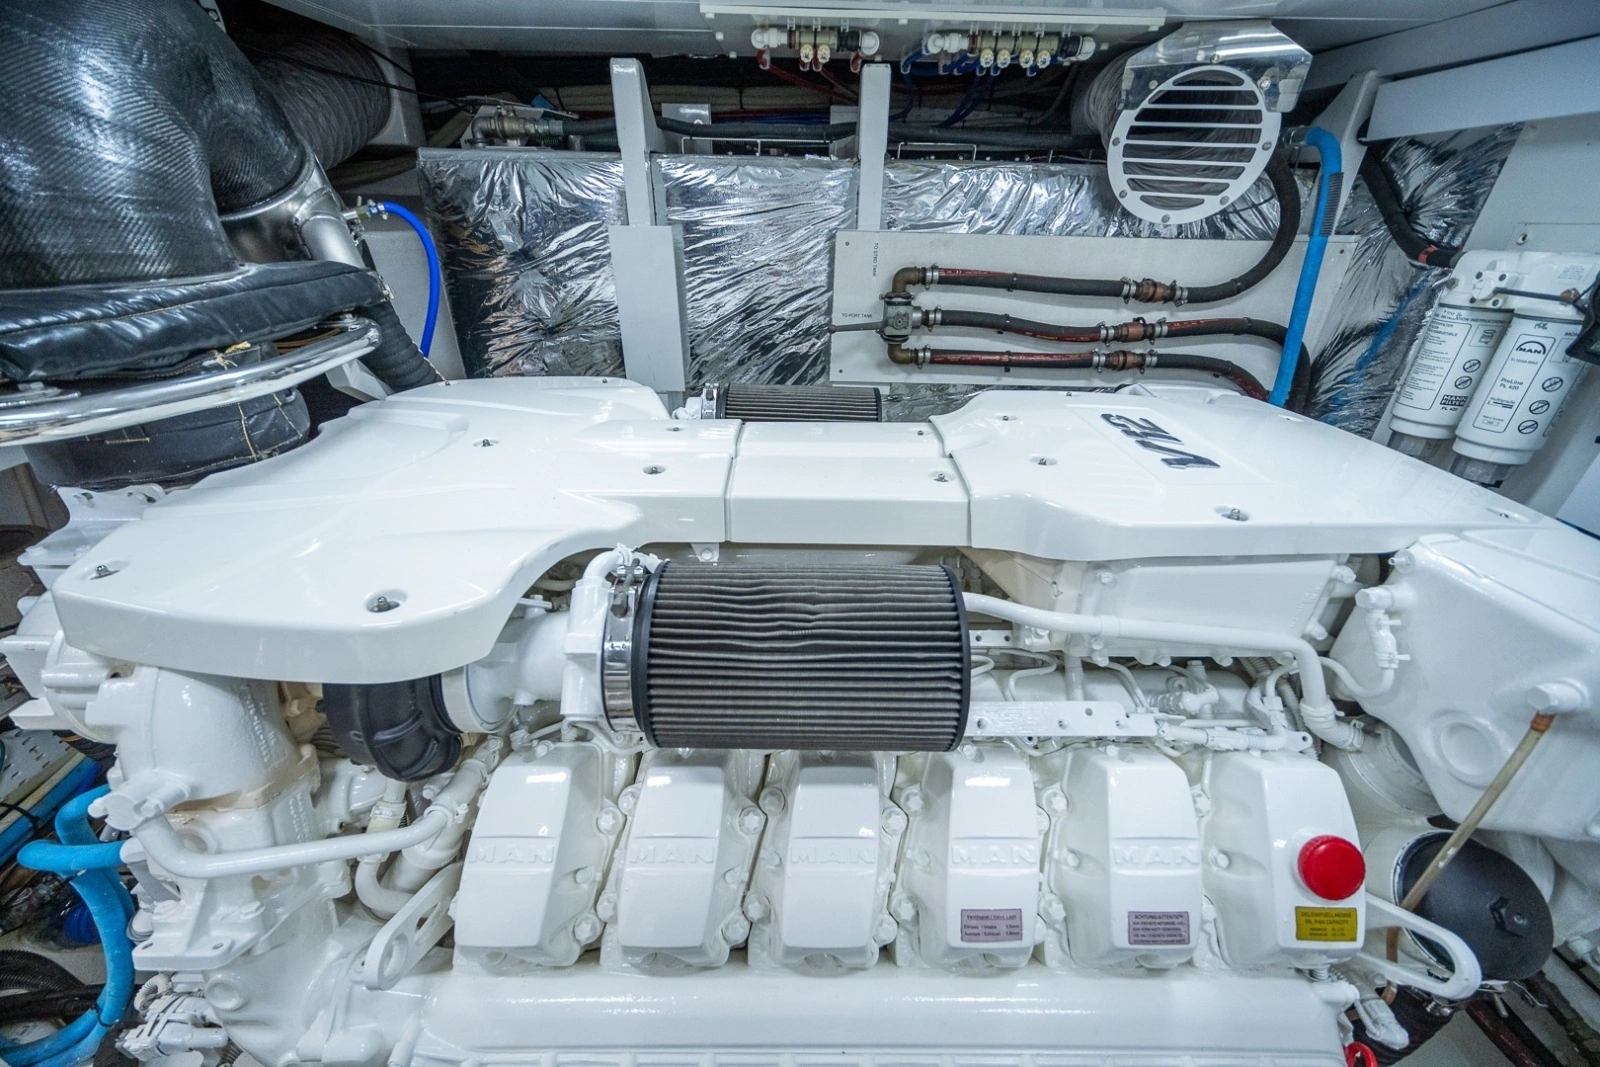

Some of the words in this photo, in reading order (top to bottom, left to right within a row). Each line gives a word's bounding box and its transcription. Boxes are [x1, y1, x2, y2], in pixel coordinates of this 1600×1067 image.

[468, 845, 555, 864] MAN
[629, 845, 716, 864] MAN
[790, 846, 876, 865] MAN
[952, 845, 1038, 865] MAN
[1112, 845, 1200, 865] MAN
